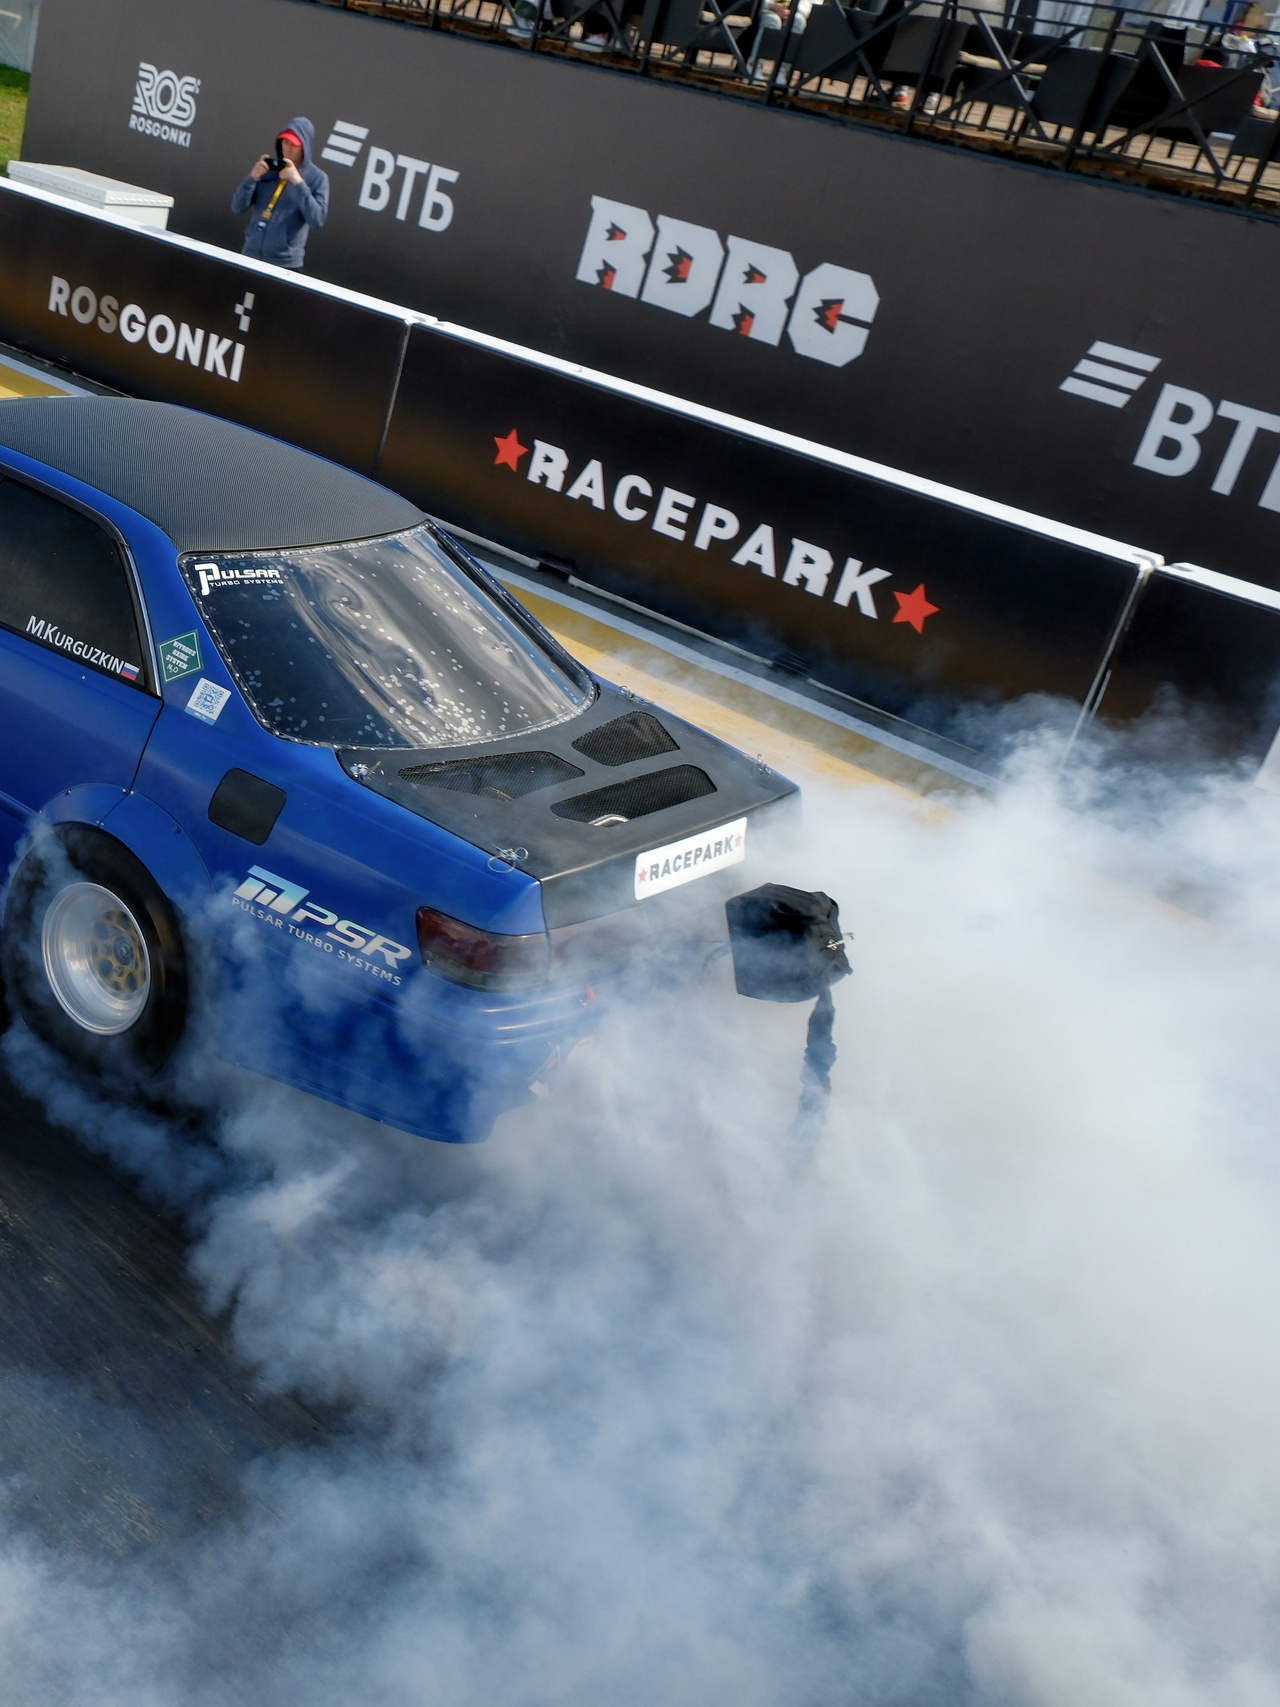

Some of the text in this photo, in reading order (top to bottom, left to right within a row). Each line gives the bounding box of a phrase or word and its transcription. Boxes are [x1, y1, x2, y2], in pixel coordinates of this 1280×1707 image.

[132, 61, 201, 128] ROS
[128, 113, 192, 148] ROSGONKI
[358, 145, 460, 232] ВТБ
[575, 194, 880, 368] RDRC
[48, 275, 246, 382] ROSGONKI
[527, 439, 893, 619] RACEPARK
[194, 562, 280, 596] PULSAR
[209, 579, 240, 587] TURBO
[165, 654, 188, 670] SYSTEM
[649, 834, 735, 881] RACEPARK
[231, 897, 402, 987] PULSAR TURBO SYSTEMS
